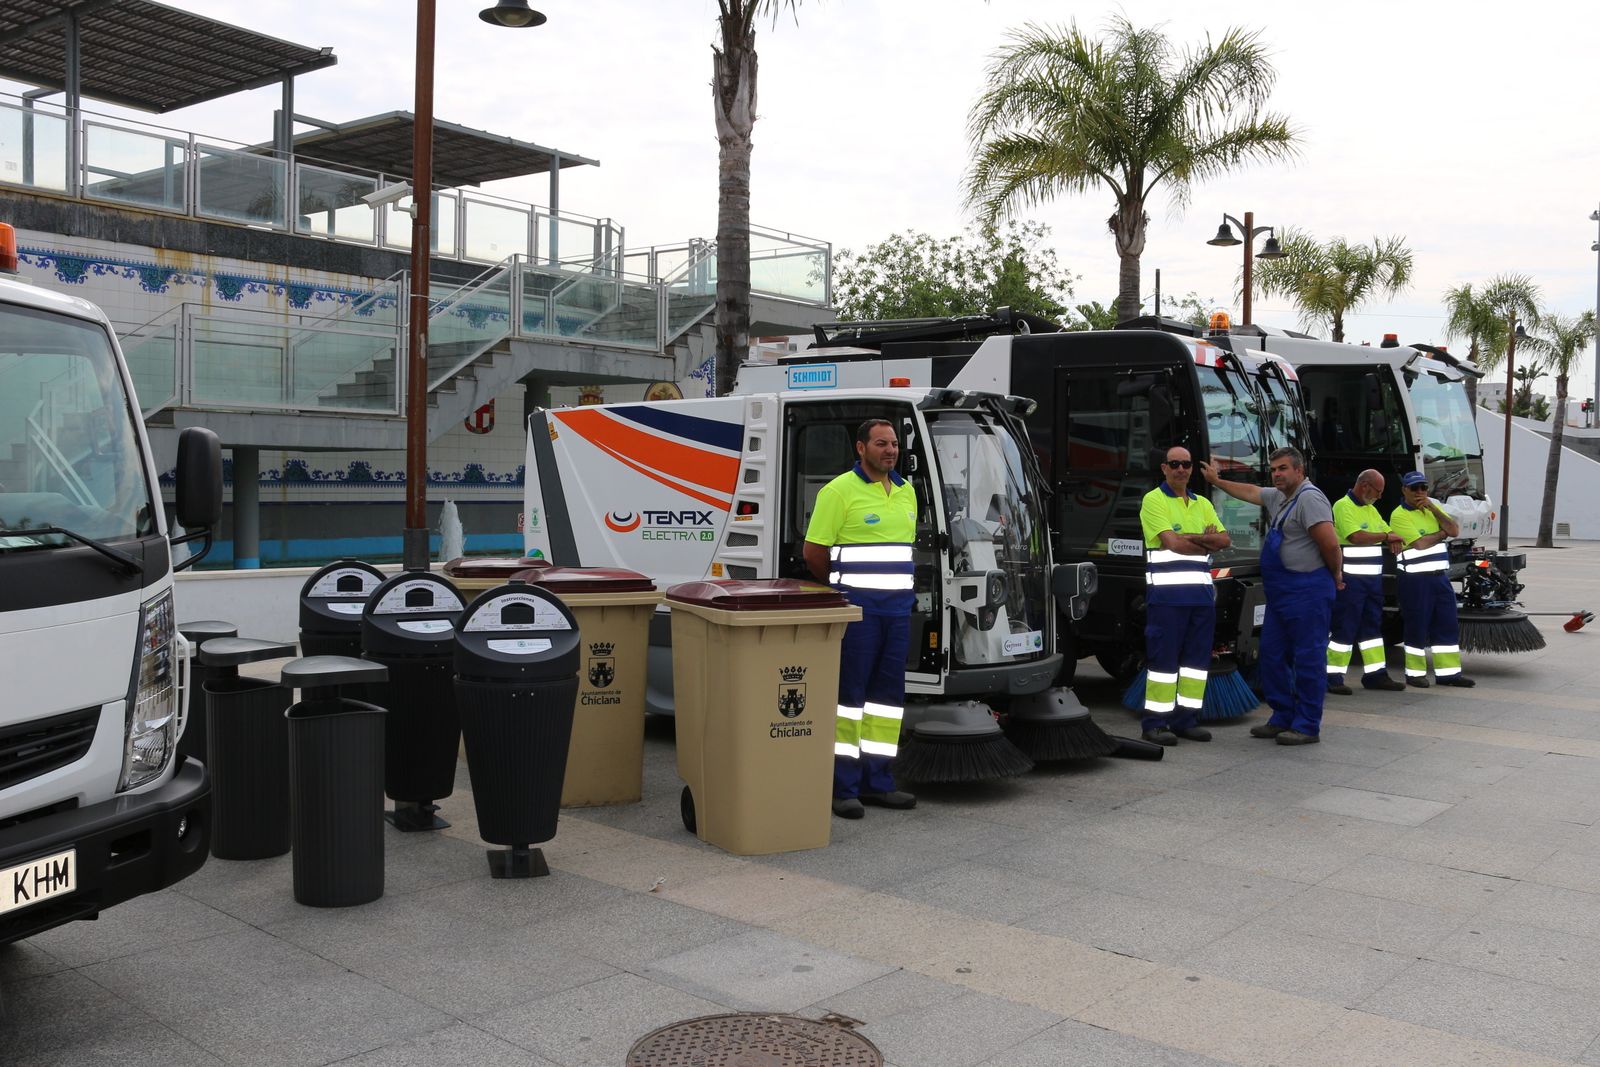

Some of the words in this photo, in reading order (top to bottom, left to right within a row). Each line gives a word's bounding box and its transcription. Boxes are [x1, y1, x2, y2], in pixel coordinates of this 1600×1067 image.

[793, 371, 831, 382] SCHMIDT
[643, 510, 714, 525] TENAX
[642, 531, 697, 541] ELECTRA
[702, 532, 713, 540] 2.0
[581, 695, 621, 705] Chiclana
[770, 720, 805, 728] Ayuntamiento
[769, 727, 812, 738] Chiclana
[14, 857, 69, 905] KHM
